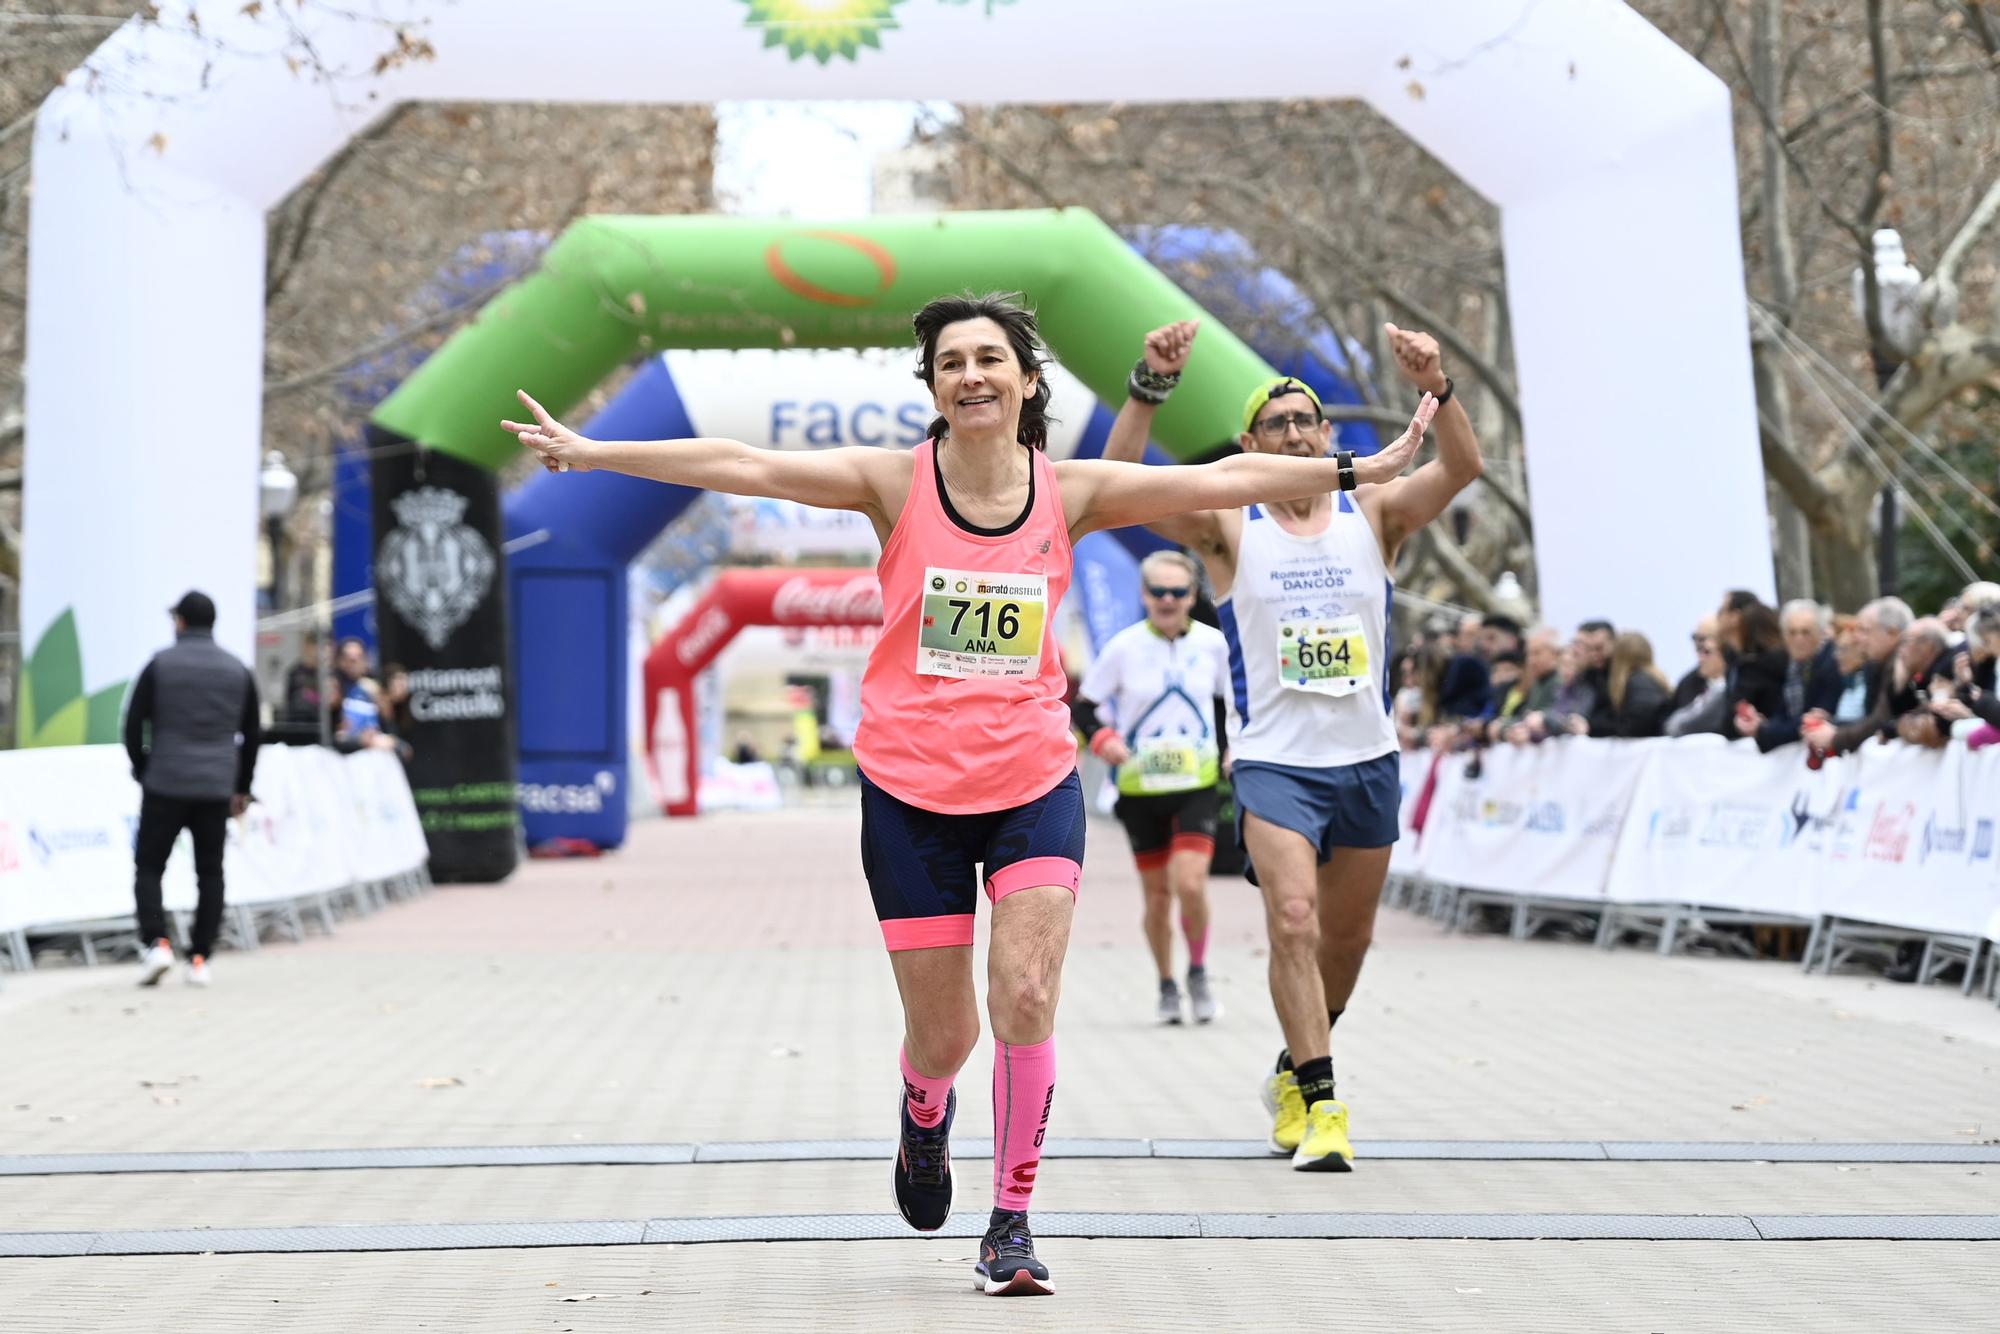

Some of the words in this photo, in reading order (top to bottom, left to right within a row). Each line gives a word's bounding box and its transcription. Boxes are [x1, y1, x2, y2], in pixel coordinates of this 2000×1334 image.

[770, 399, 929, 445] Facs
[1269, 568, 1323, 581] Romeral
[1326, 566, 1352, 576] Vivo
[1283, 576, 1345, 591] DANCOS
[948, 599, 1020, 640] 716
[964, 639, 997, 654] ANA
[1298, 639, 1351, 668] 664
